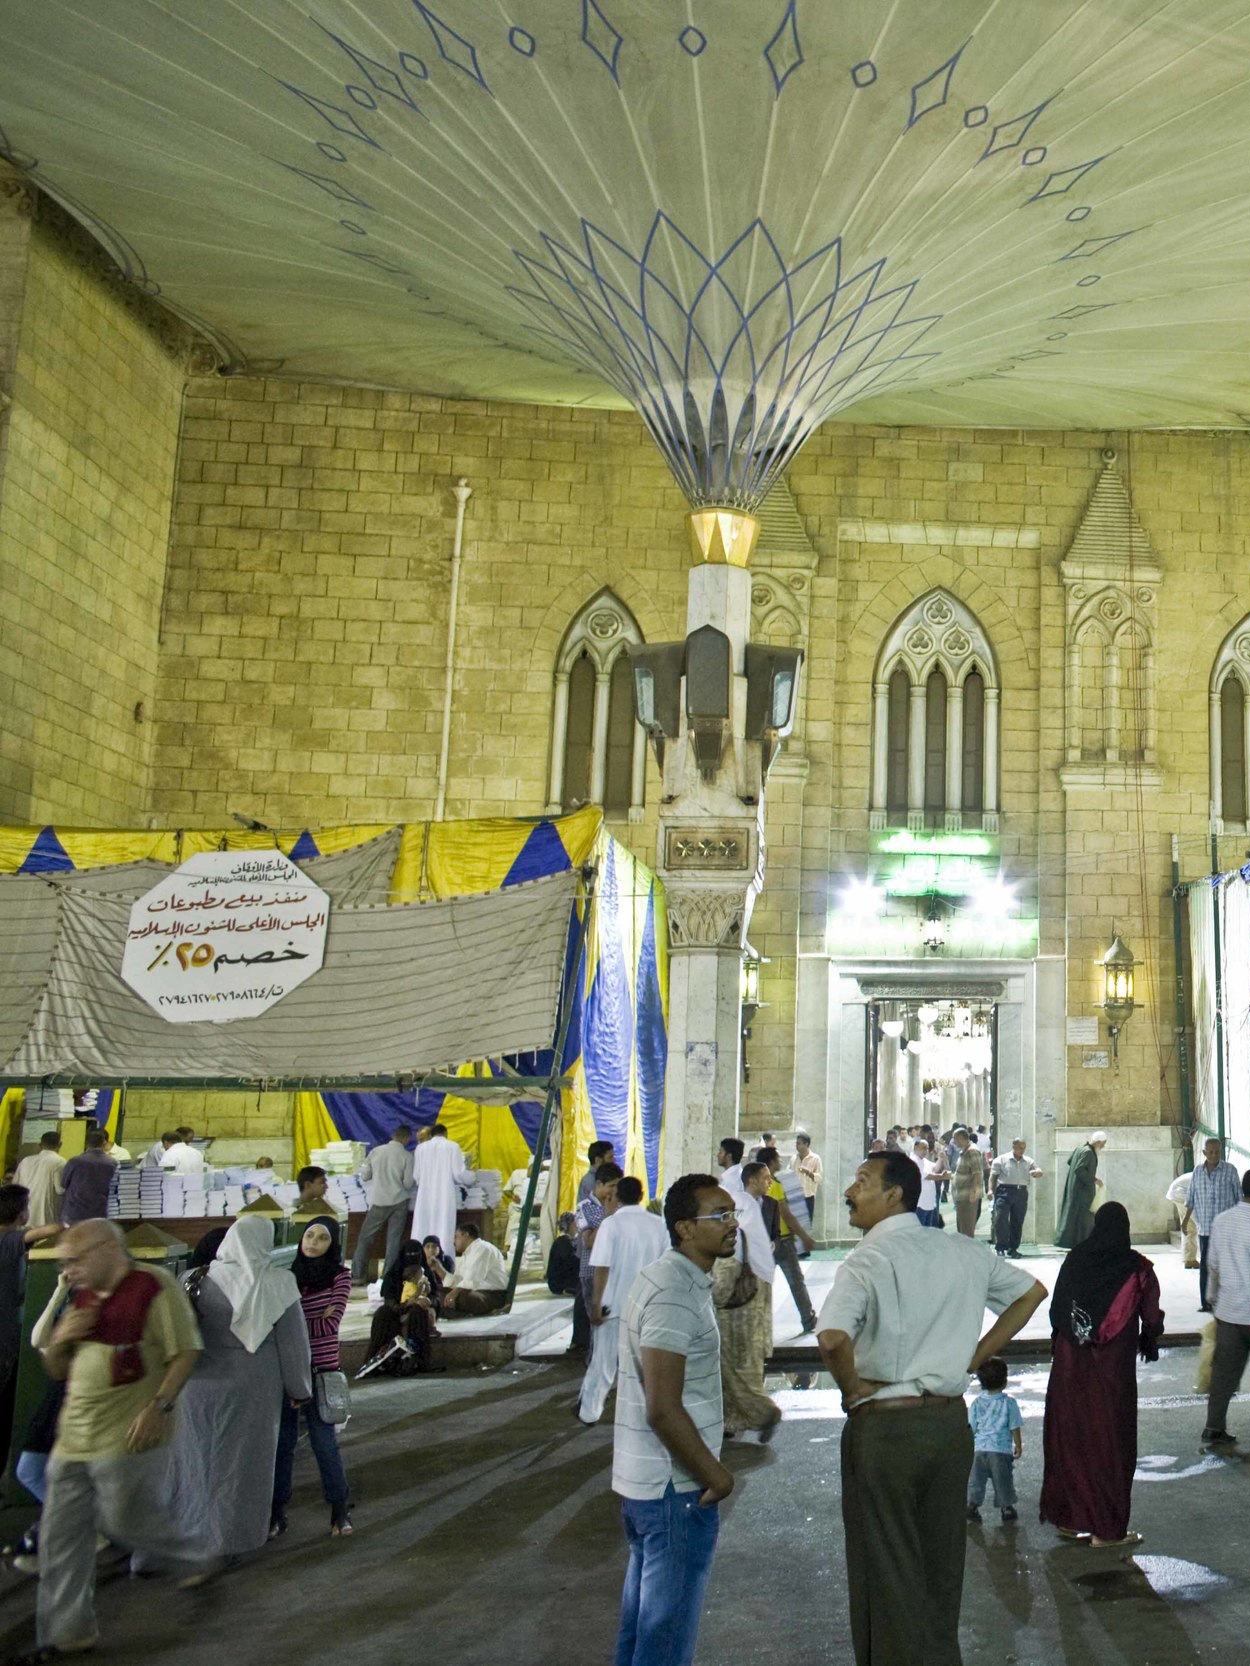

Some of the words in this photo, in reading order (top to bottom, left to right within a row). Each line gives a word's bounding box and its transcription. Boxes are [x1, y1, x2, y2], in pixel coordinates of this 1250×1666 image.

[147, 889, 226, 913] مطبوعات
[224, 892, 263, 910] بيع
[262, 891, 308, 907] منفذ
[280, 912, 326, 932] المجلس
[213, 941, 310, 974] خصم
